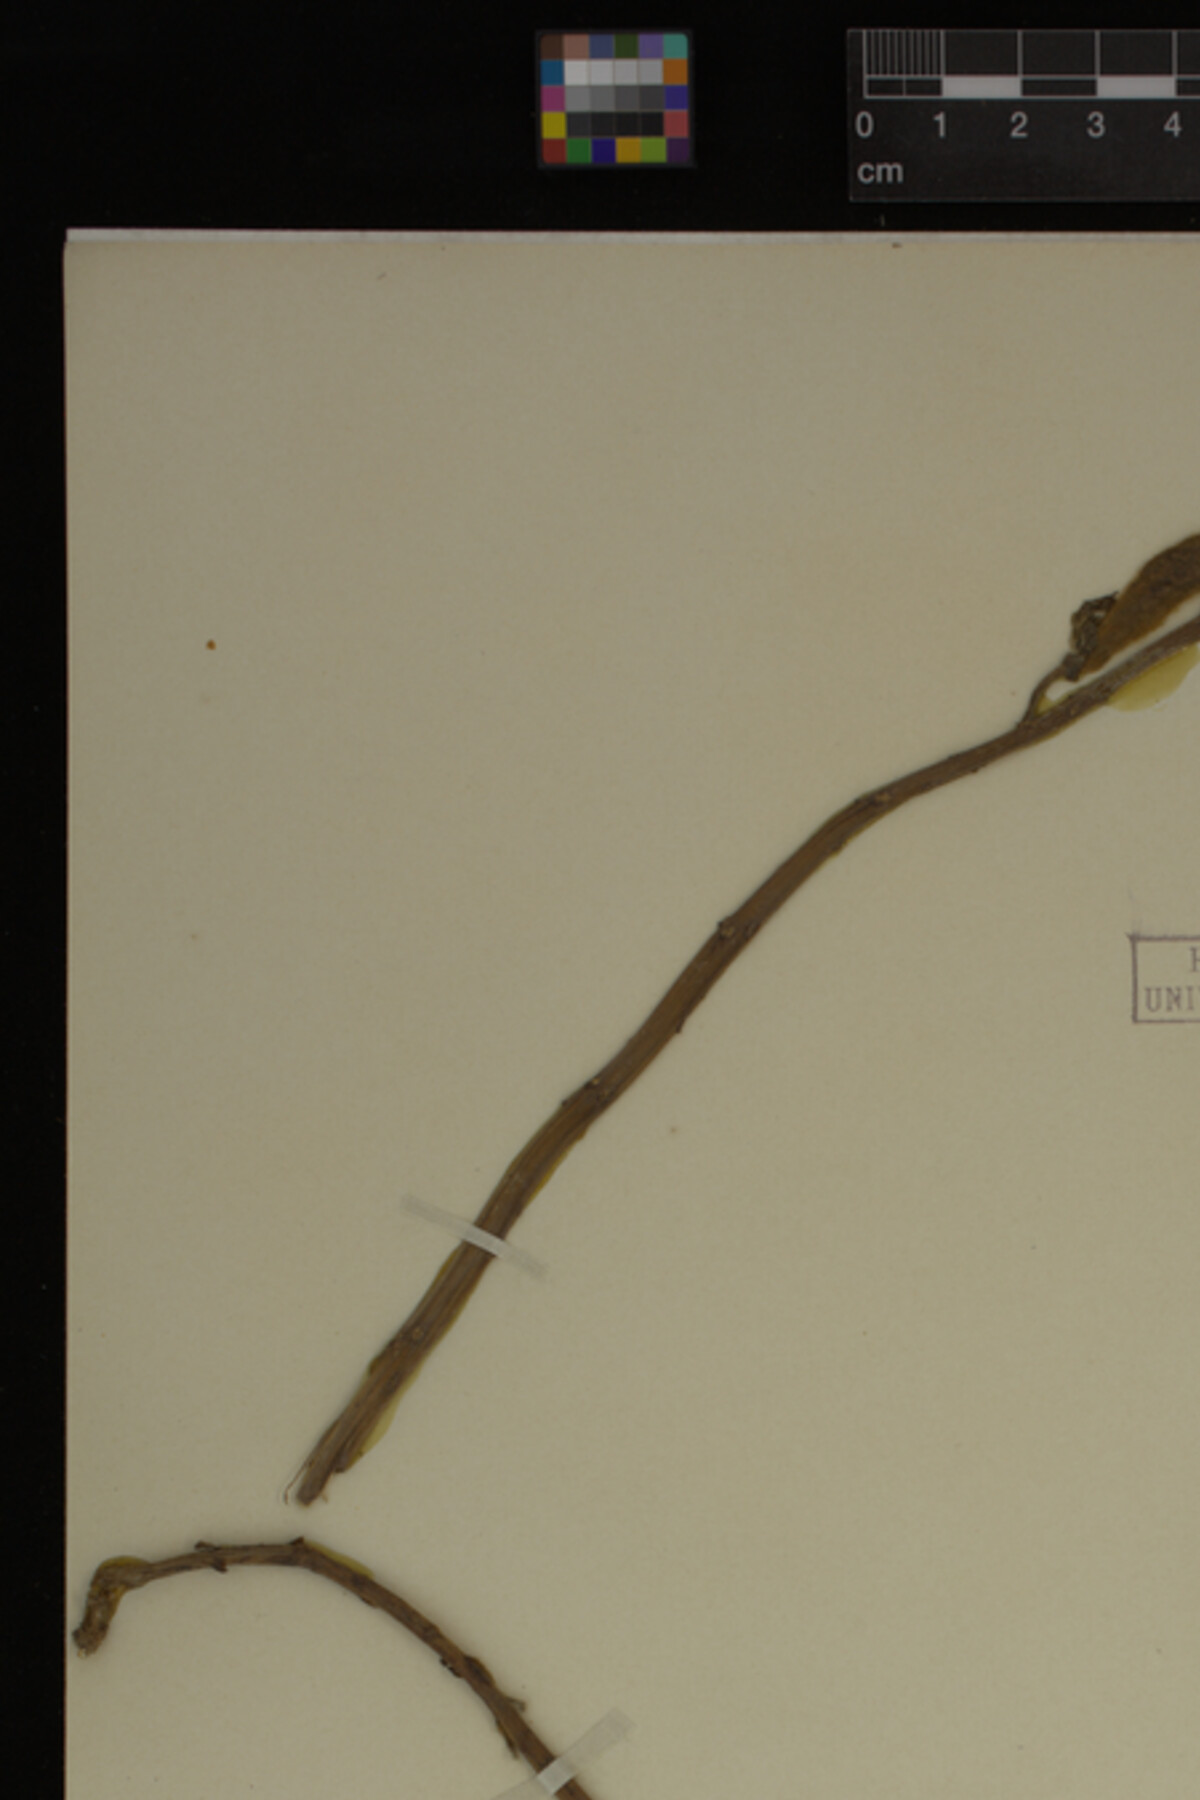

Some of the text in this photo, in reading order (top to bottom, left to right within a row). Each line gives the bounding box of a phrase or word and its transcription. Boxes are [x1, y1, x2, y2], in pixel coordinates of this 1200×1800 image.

[855, 110, 874, 138] 0
[933, 111, 945, 138] 1
[1010, 111, 1028, 138] 2
[1087, 111, 1106, 138] 3
[1163, 111, 1182, 137] 4
[857, 162, 904, 184] cm
